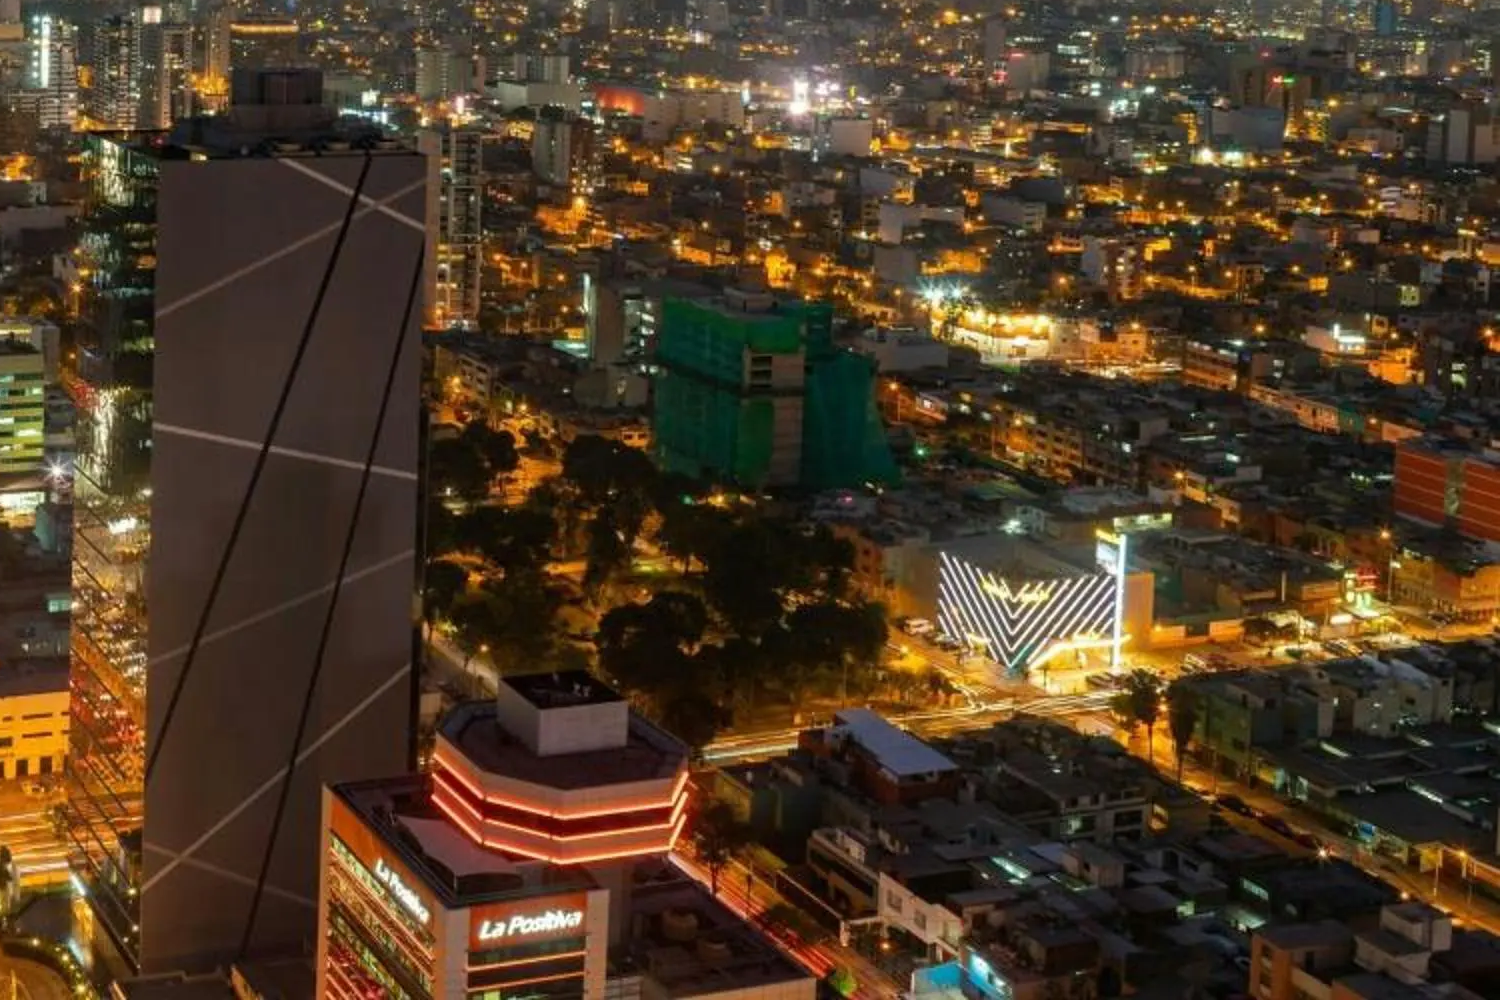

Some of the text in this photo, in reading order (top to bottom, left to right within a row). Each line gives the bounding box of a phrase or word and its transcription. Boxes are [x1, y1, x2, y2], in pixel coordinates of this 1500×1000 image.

[375, 858, 390, 883] La
[479, 910, 583, 940] La Positiva
